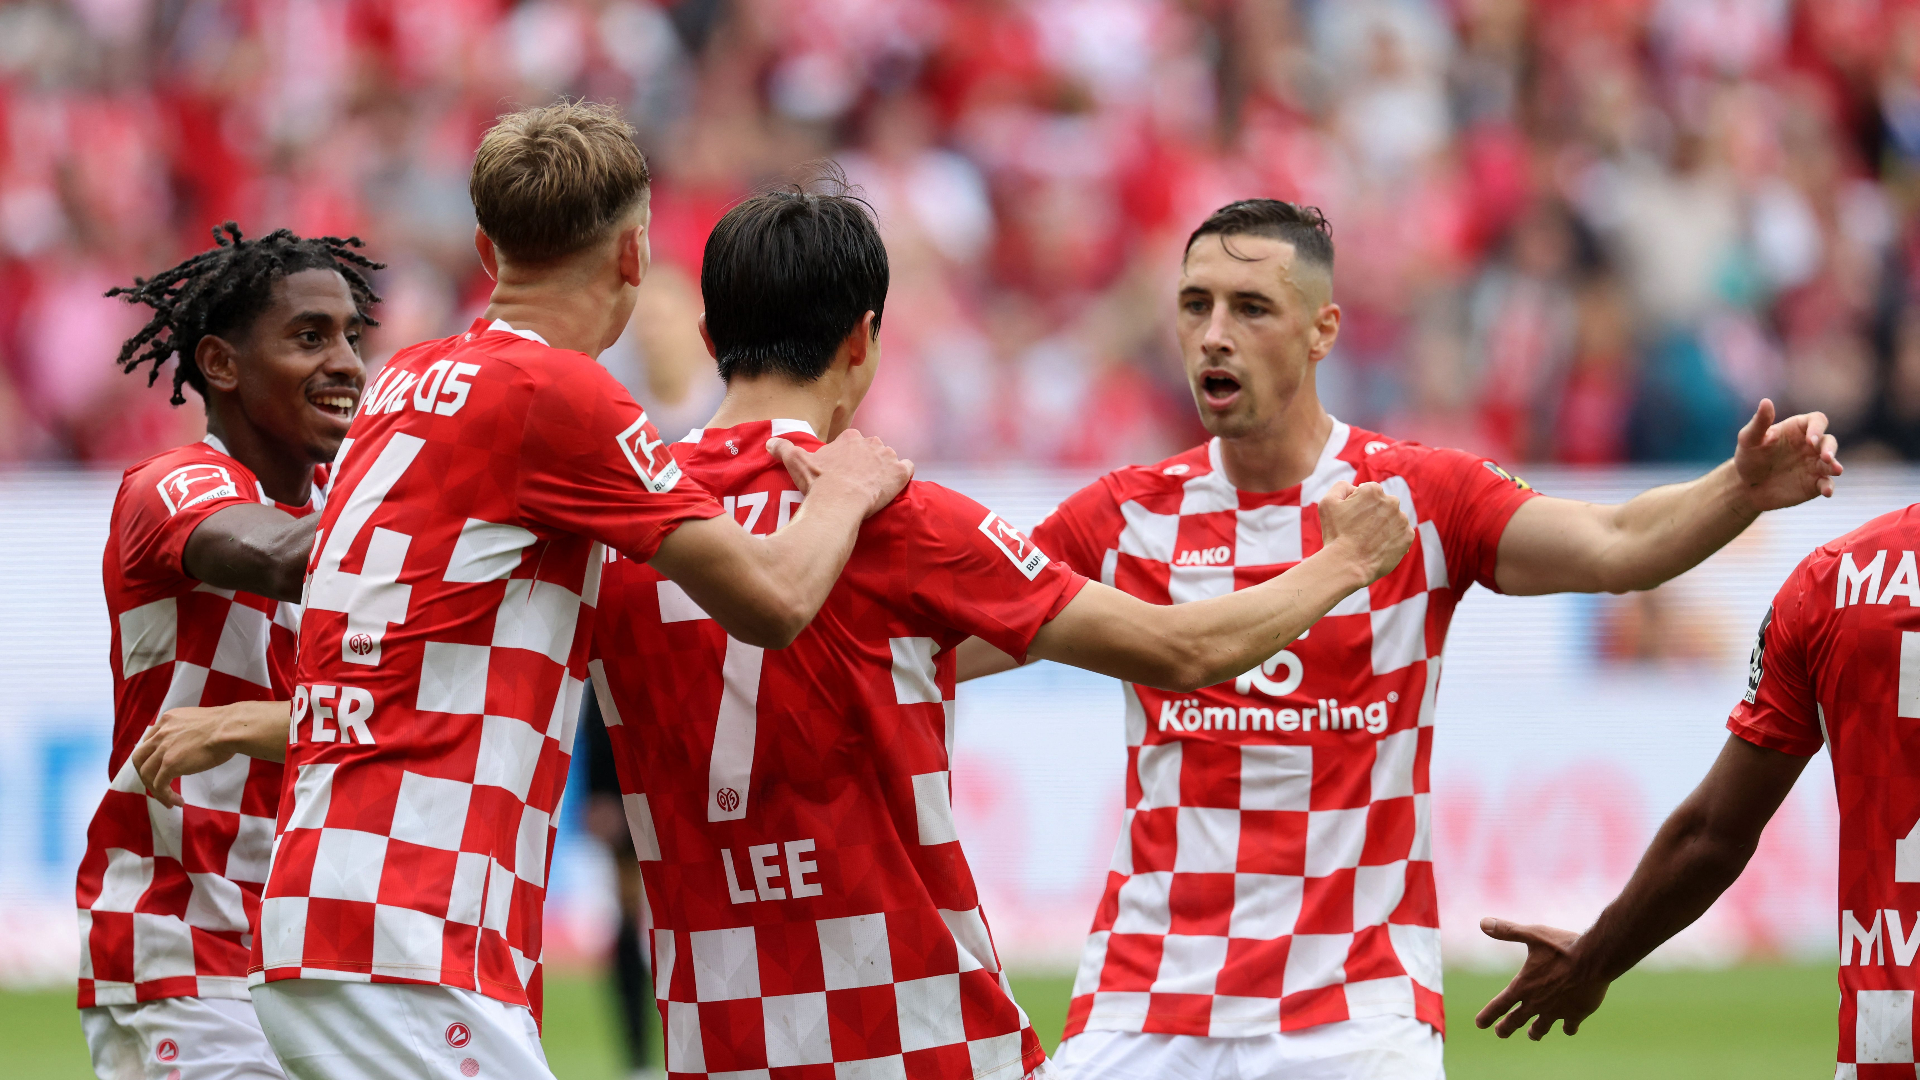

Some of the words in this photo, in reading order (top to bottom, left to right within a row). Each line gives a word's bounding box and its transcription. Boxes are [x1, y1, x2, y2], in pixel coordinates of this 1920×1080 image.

[413, 360, 481, 417] 05
[1175, 546, 1231, 566] JAKO
[1835, 549, 1920, 609] MA
[1158, 698, 1389, 735] Kömmerling
[721, 838, 823, 904] LEE
